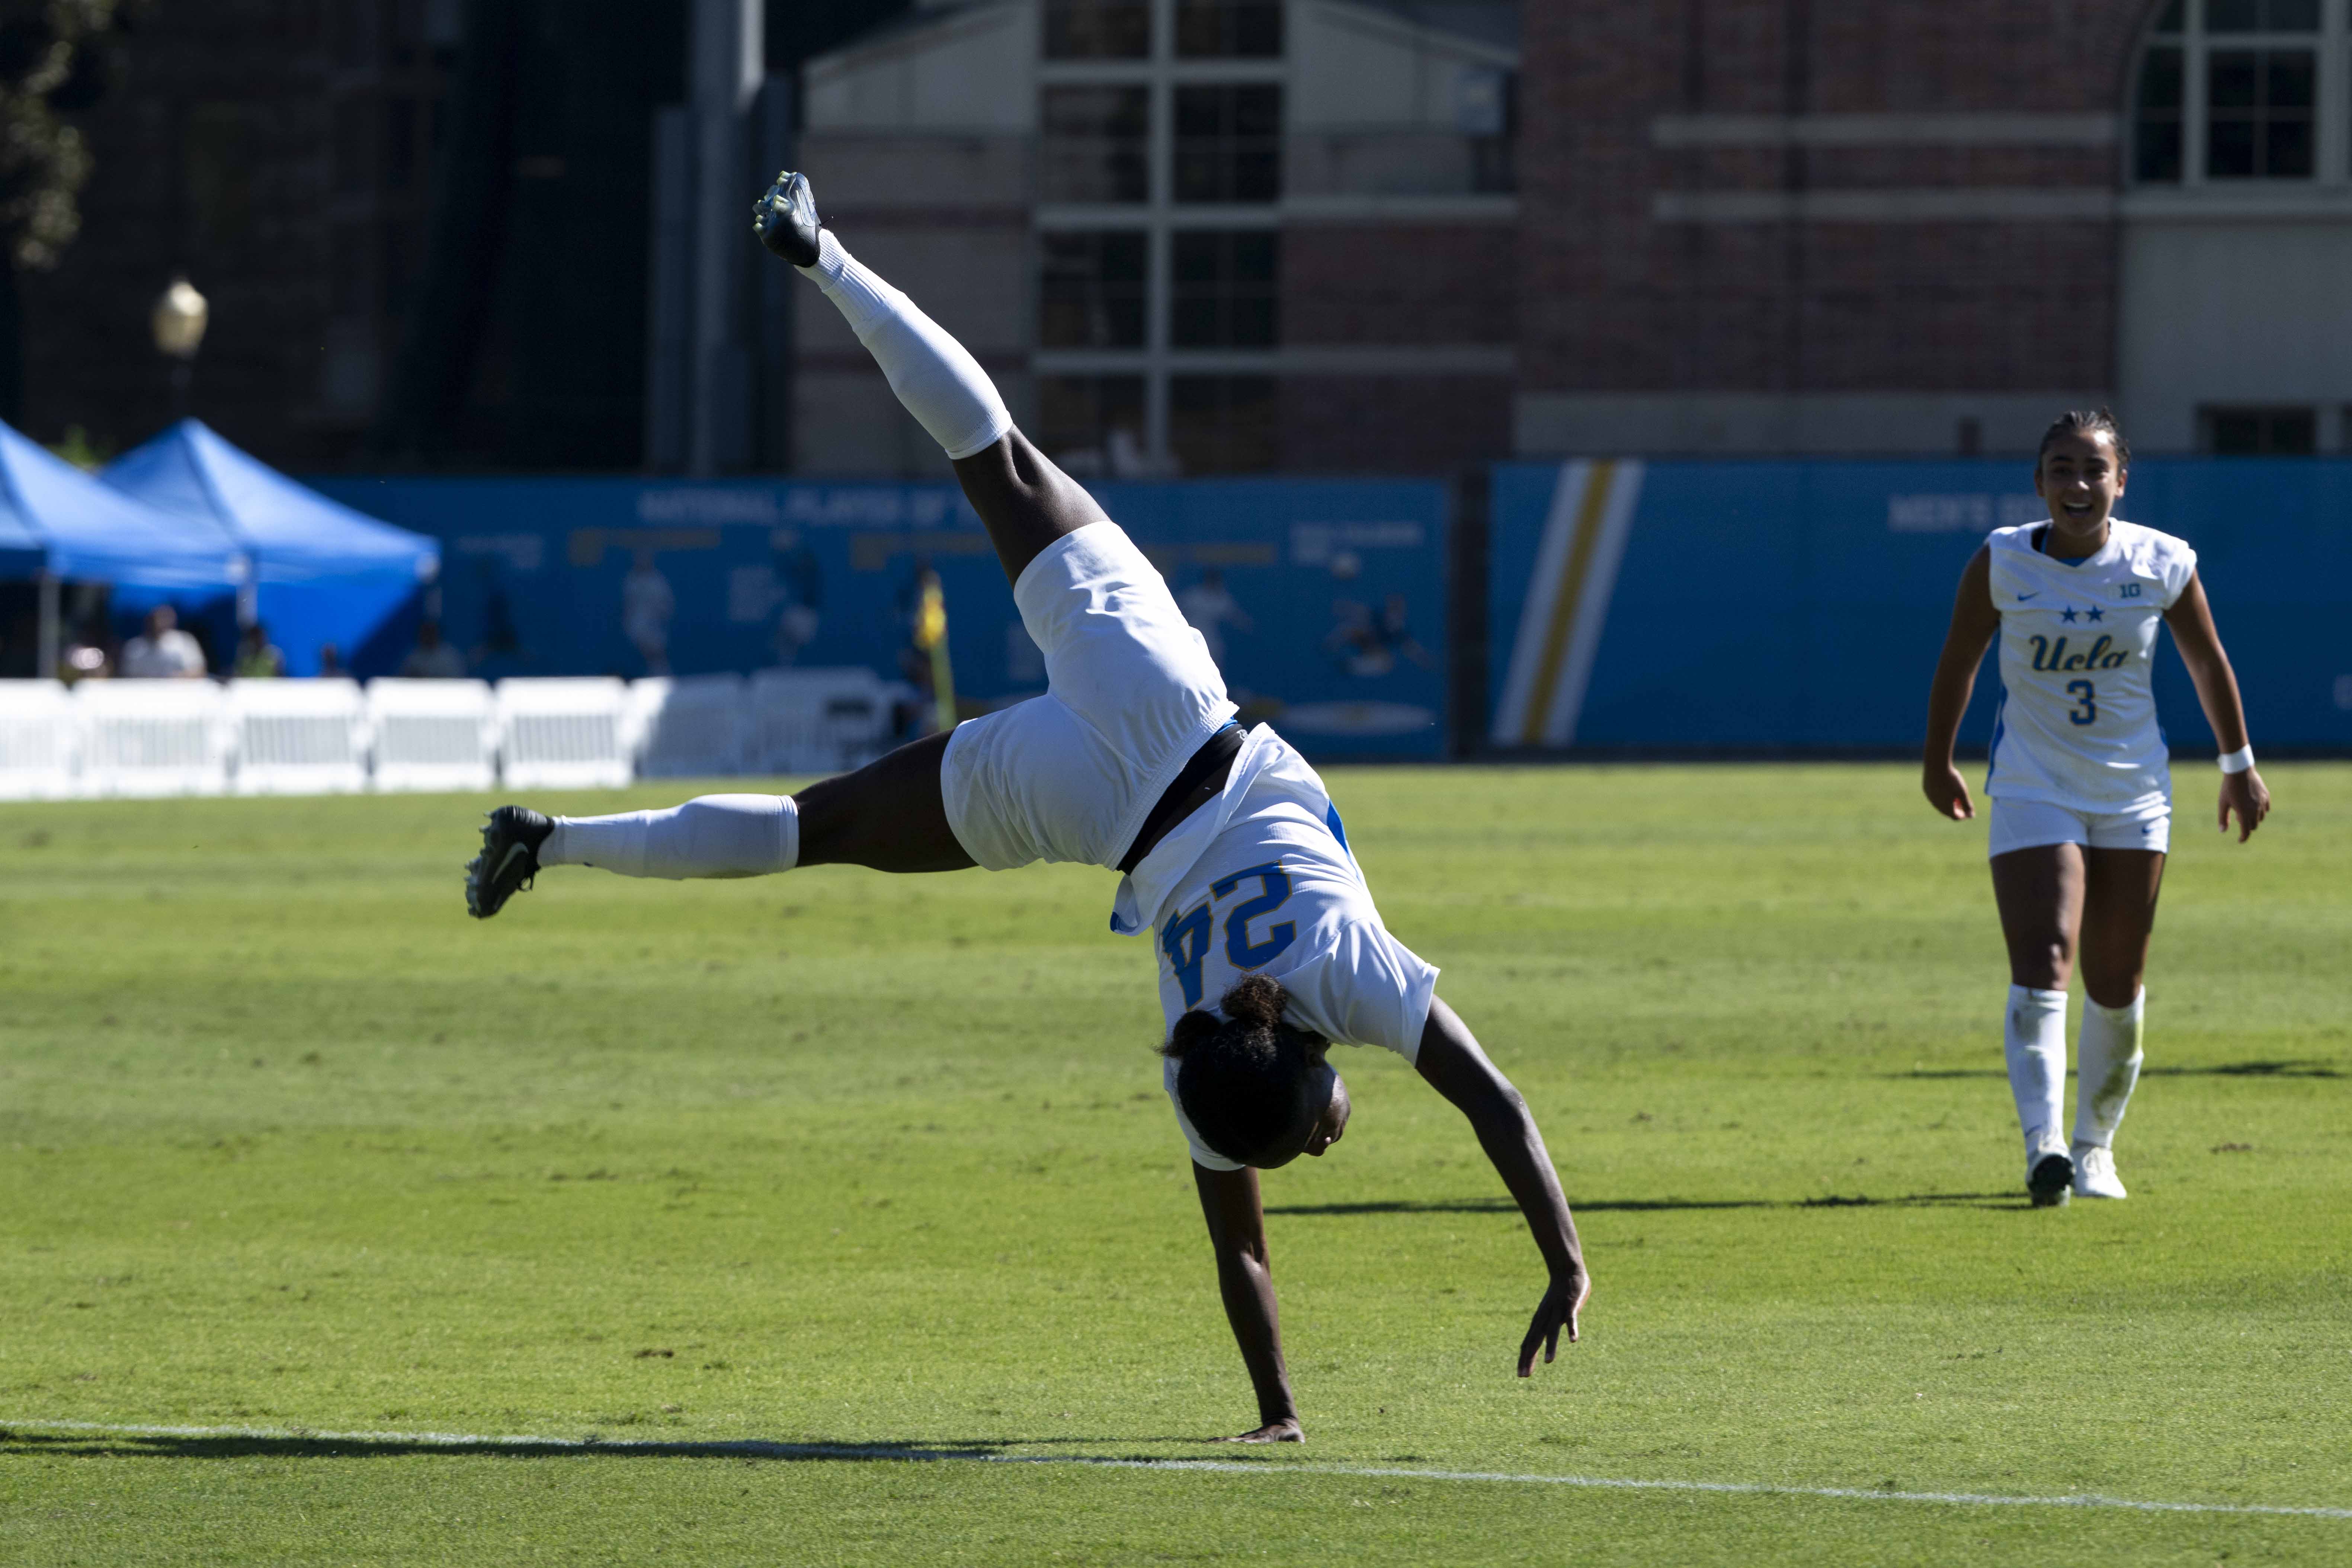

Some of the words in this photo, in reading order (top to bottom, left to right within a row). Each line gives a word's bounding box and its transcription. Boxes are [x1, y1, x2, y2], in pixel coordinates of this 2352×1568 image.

[2029, 635, 2129, 671] Ucla
[2067, 680, 2096, 726] 3
[1161, 860, 1297, 1011] 24
